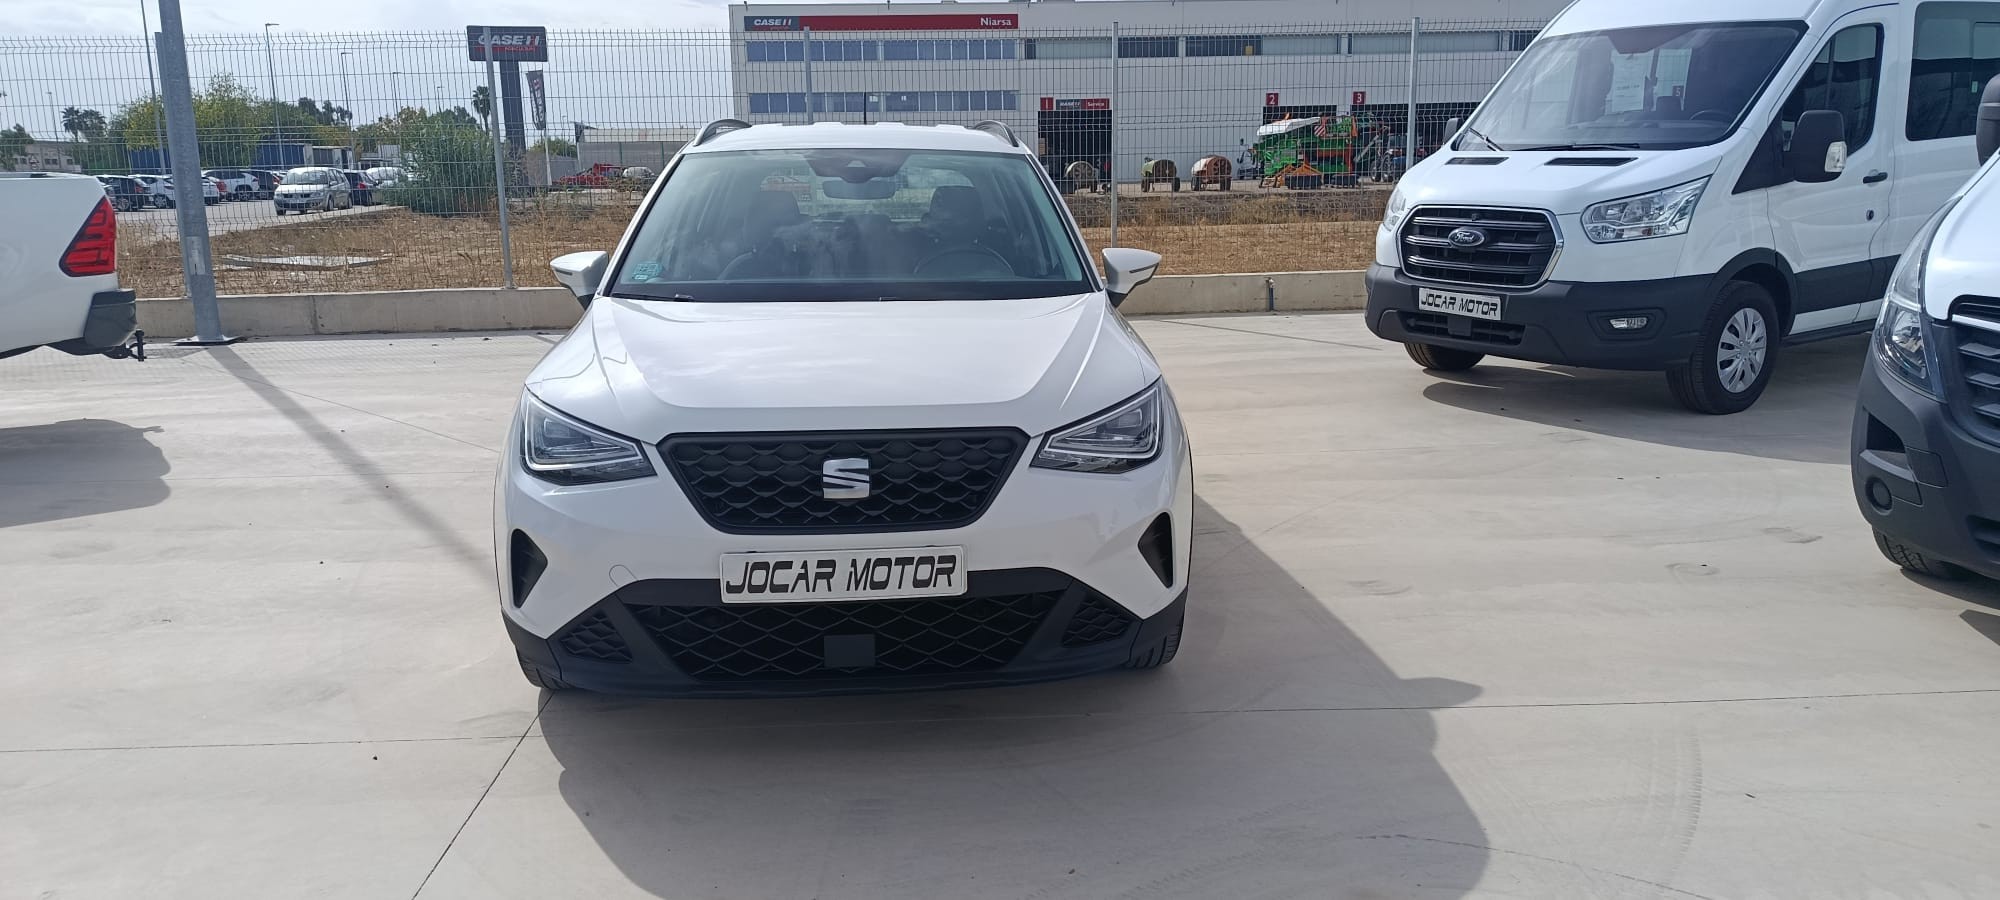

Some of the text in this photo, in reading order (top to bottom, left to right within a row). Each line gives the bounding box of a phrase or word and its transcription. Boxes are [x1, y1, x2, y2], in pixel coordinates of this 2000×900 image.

[754, 18, 781, 26] CASE
[980, 17, 1012, 26] Niarsa
[1269, 95, 1275, 104] 2
[1357, 93, 1362, 102] 3
[1421, 293, 1498, 317] JOCAR MOTOR
[725, 554, 957, 595] JOCAR MOTOR
